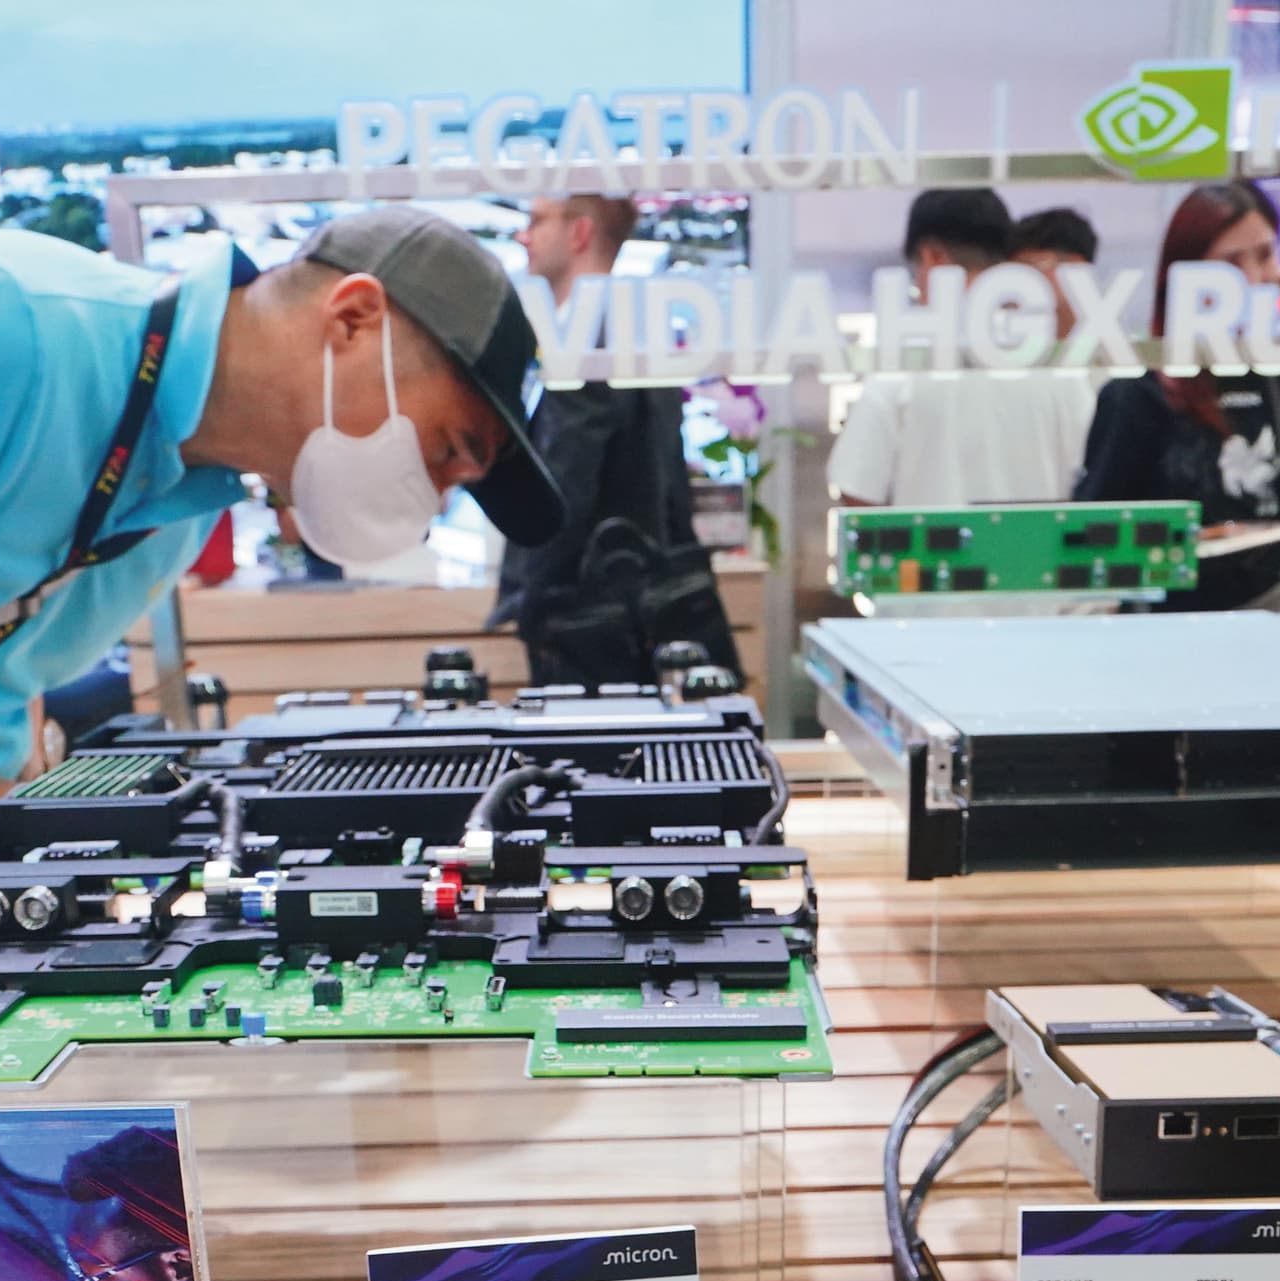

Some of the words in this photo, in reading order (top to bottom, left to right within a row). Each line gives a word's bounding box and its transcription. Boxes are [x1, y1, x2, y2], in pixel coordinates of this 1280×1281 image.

[340, 87, 920, 198] PEGATRON
[520, 270, 855, 389] VIDIA
[874, 262, 1147, 386] HGX
[602, 1246, 678, 1265] micron
